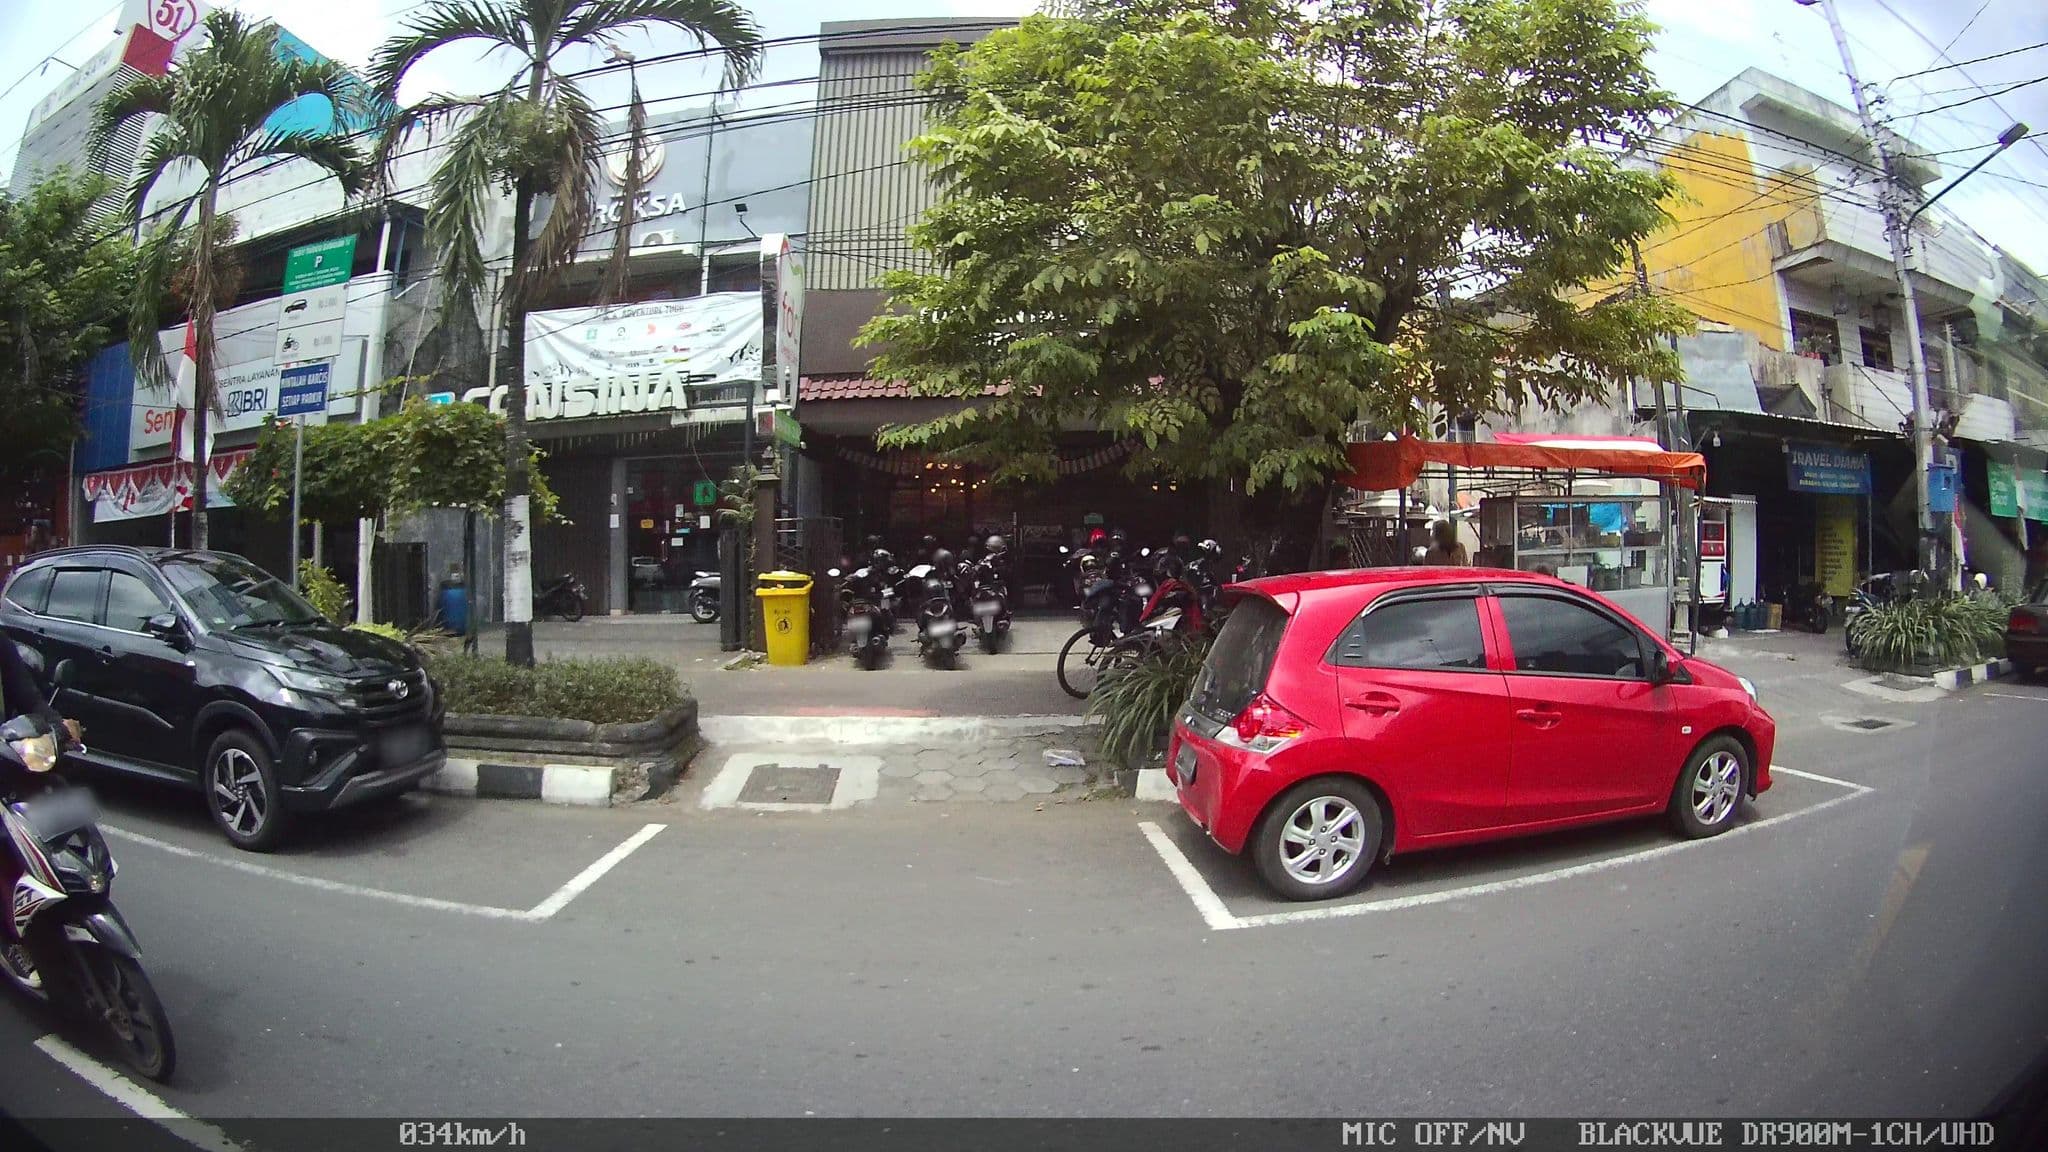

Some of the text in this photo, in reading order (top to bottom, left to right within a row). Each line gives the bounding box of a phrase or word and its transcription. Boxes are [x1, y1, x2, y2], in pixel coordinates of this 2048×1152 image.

[156, 0, 184, 34] 51
[314, 255, 323, 268] P
[218, 368, 280, 388] SENTRA LAYANAN
[243, 387, 268, 412] BRI
[1792, 450, 1832, 467] TRAVEL
